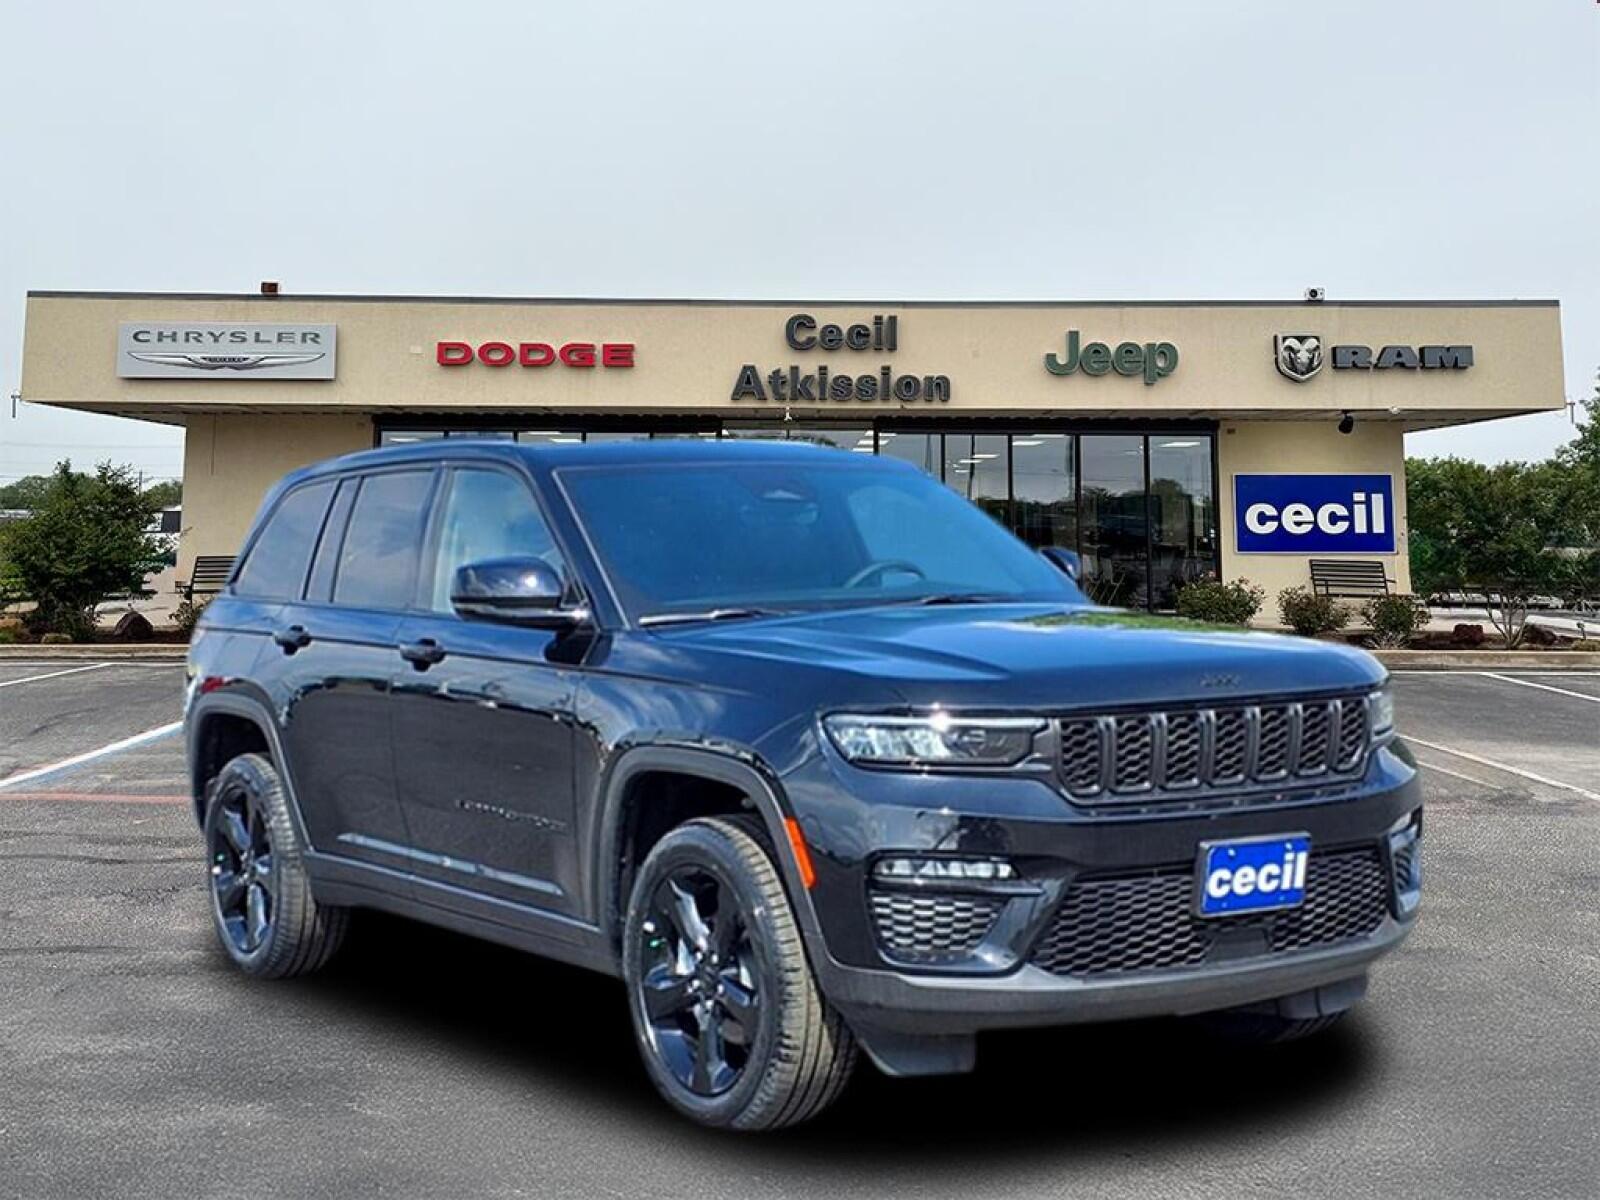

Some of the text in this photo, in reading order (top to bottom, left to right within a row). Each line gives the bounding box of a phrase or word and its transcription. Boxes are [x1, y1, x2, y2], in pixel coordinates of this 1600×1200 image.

[132, 329, 322, 345] CHRYSLER
[785, 313, 899, 353] Cecil
[436, 341, 636, 368] DODGE
[1045, 330, 1179, 386] Jeep
[1331, 345, 1474, 371] RAM
[731, 364, 951, 402] Atkission
[1244, 491, 1386, 534] cecil
[1207, 851, 1308, 899] cecil
